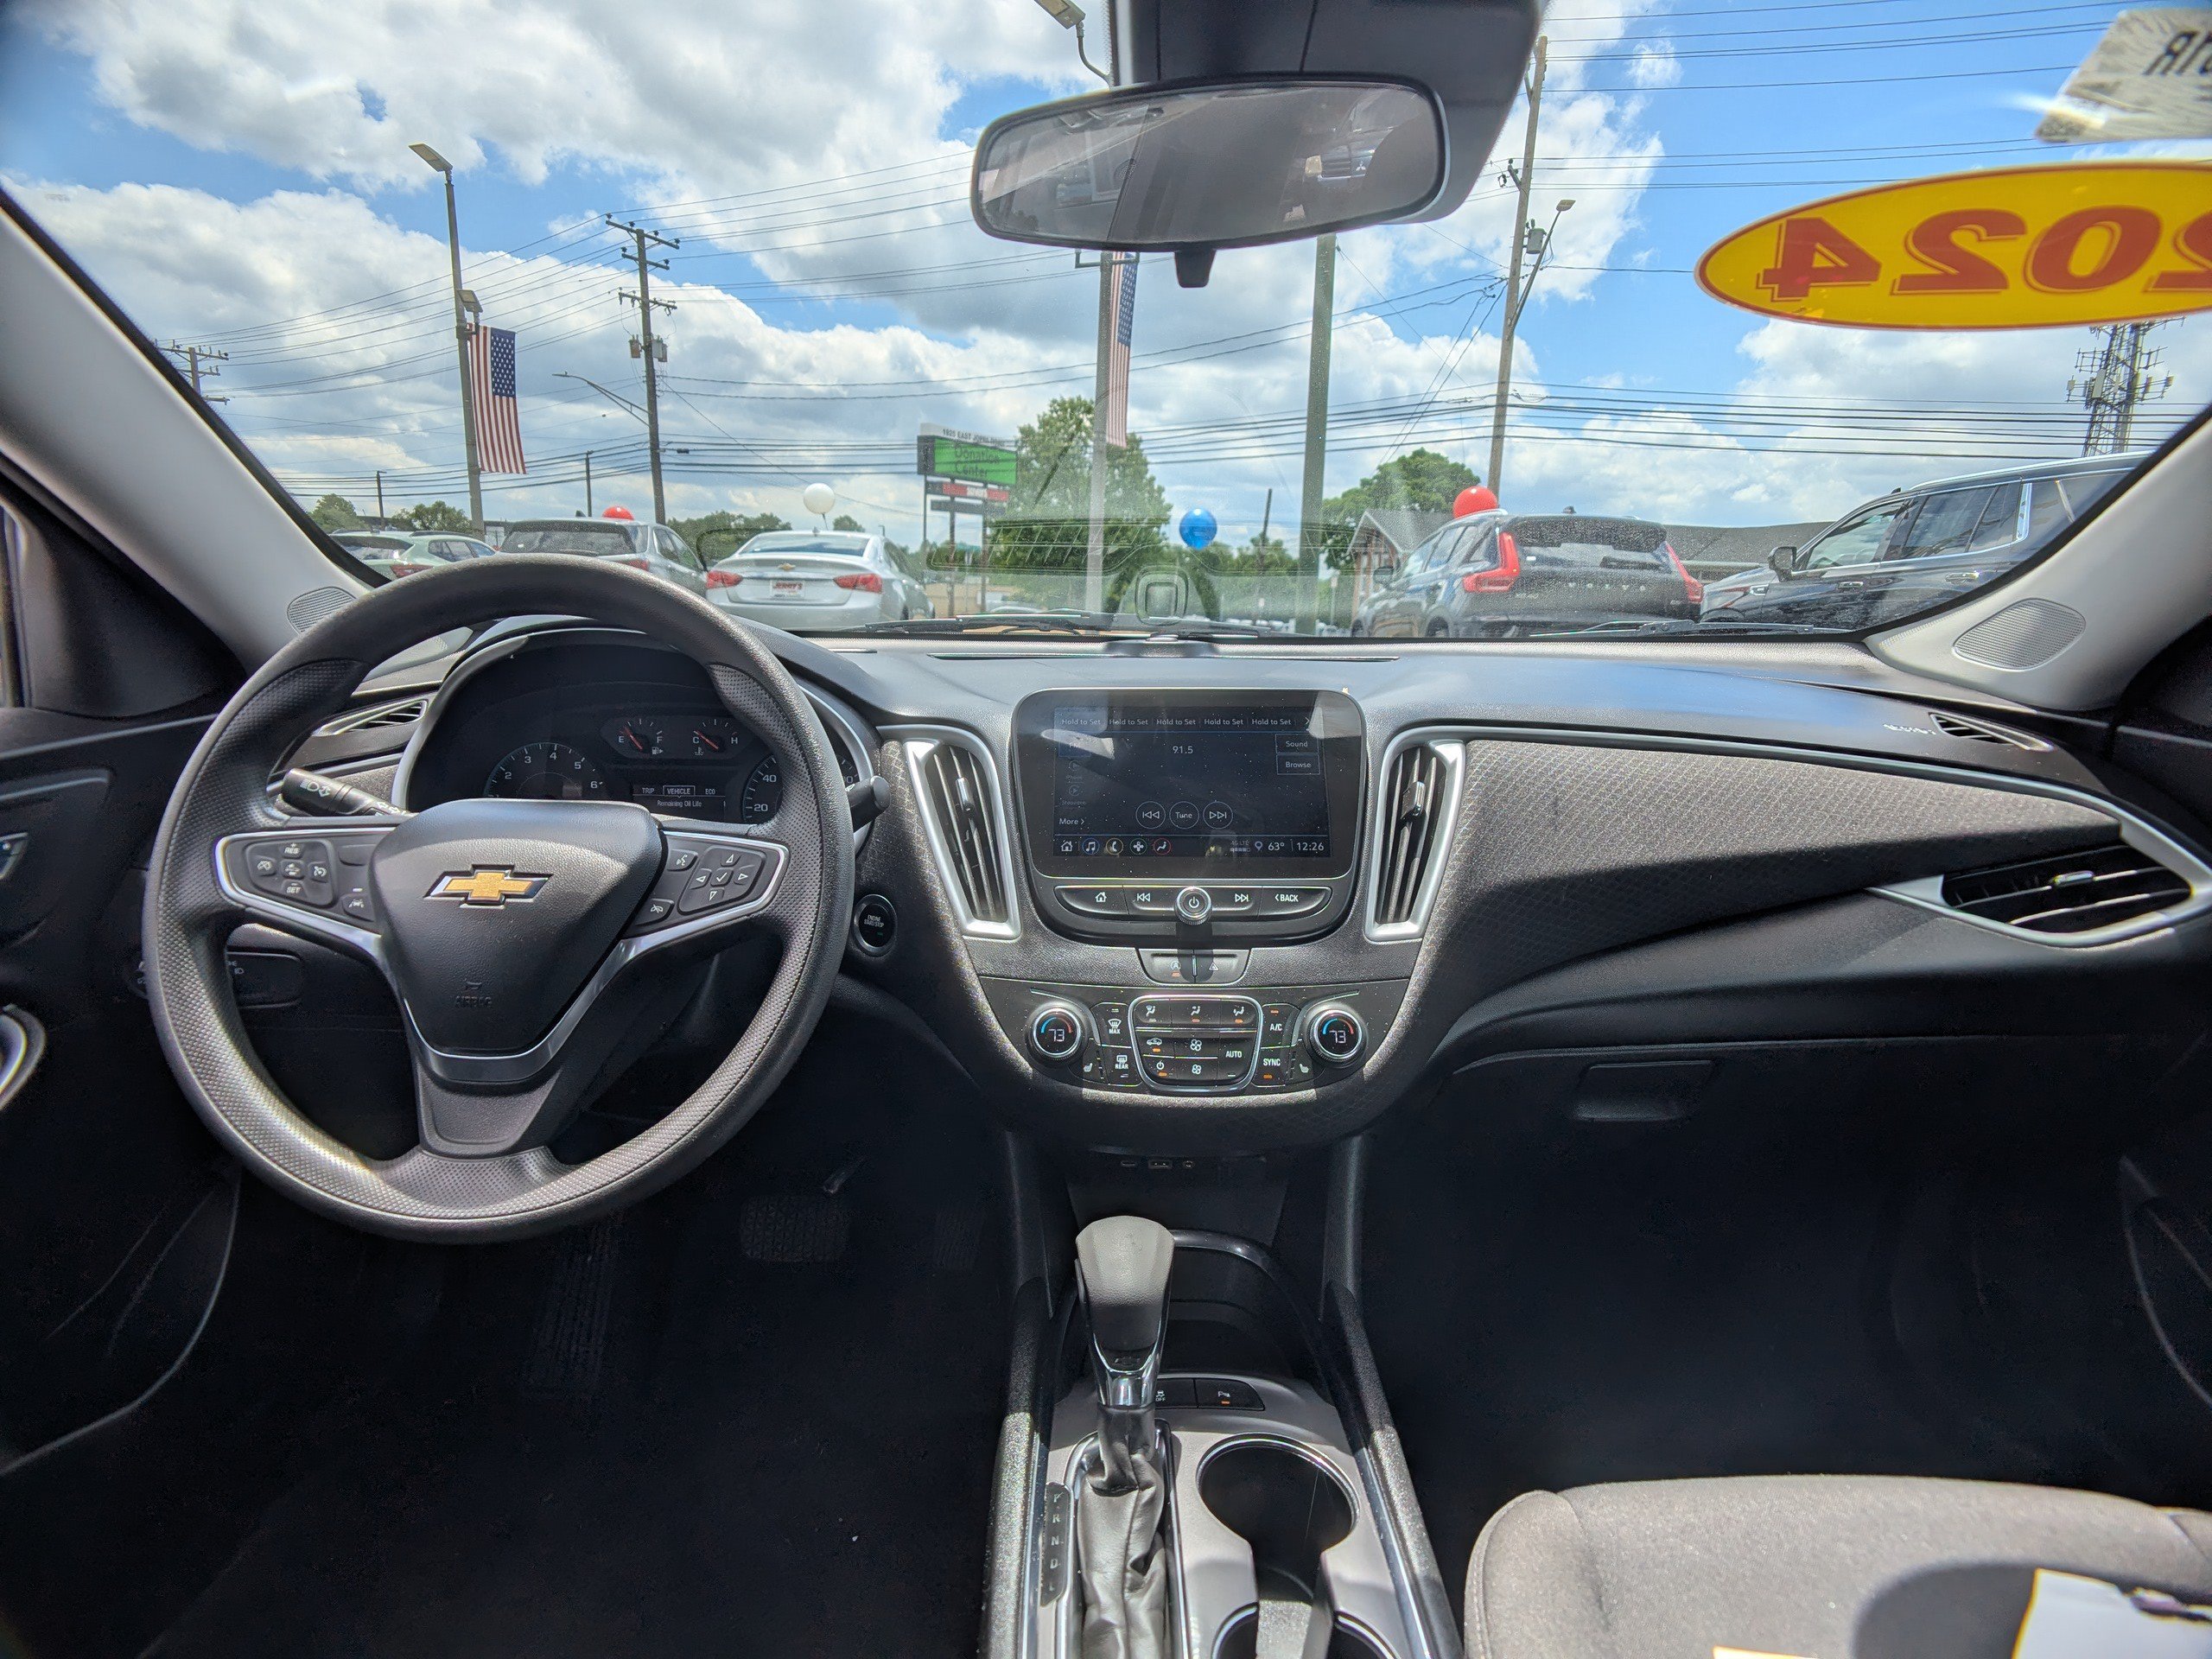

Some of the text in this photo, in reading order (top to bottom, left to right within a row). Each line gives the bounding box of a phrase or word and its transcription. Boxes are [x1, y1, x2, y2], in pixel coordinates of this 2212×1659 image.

[1567, 582, 1646, 592] VOLVO
[1173, 746, 1193, 754] 91.5
[524, 756, 531, 764] 3
[574, 761, 582, 770] 5
[505, 771, 512, 779] 2
[763, 775, 777, 783] 40
[591, 780, 598, 788] 6
[754, 804, 768, 812] 20
[1296, 842, 1325, 851] 12:26
[1280, 894, 1299, 903] BACK
[1269, 1023, 1283, 1032] A/C
[1048, 1029, 1065, 1042] 73
[1329, 1030, 1347, 1044] 73
[1262, 1058, 1281, 1067] SYNC
[1052, 1513, 1061, 1523] R
[1051, 1535, 1059, 1546] N
[1049, 1558, 1059, 1569] D
